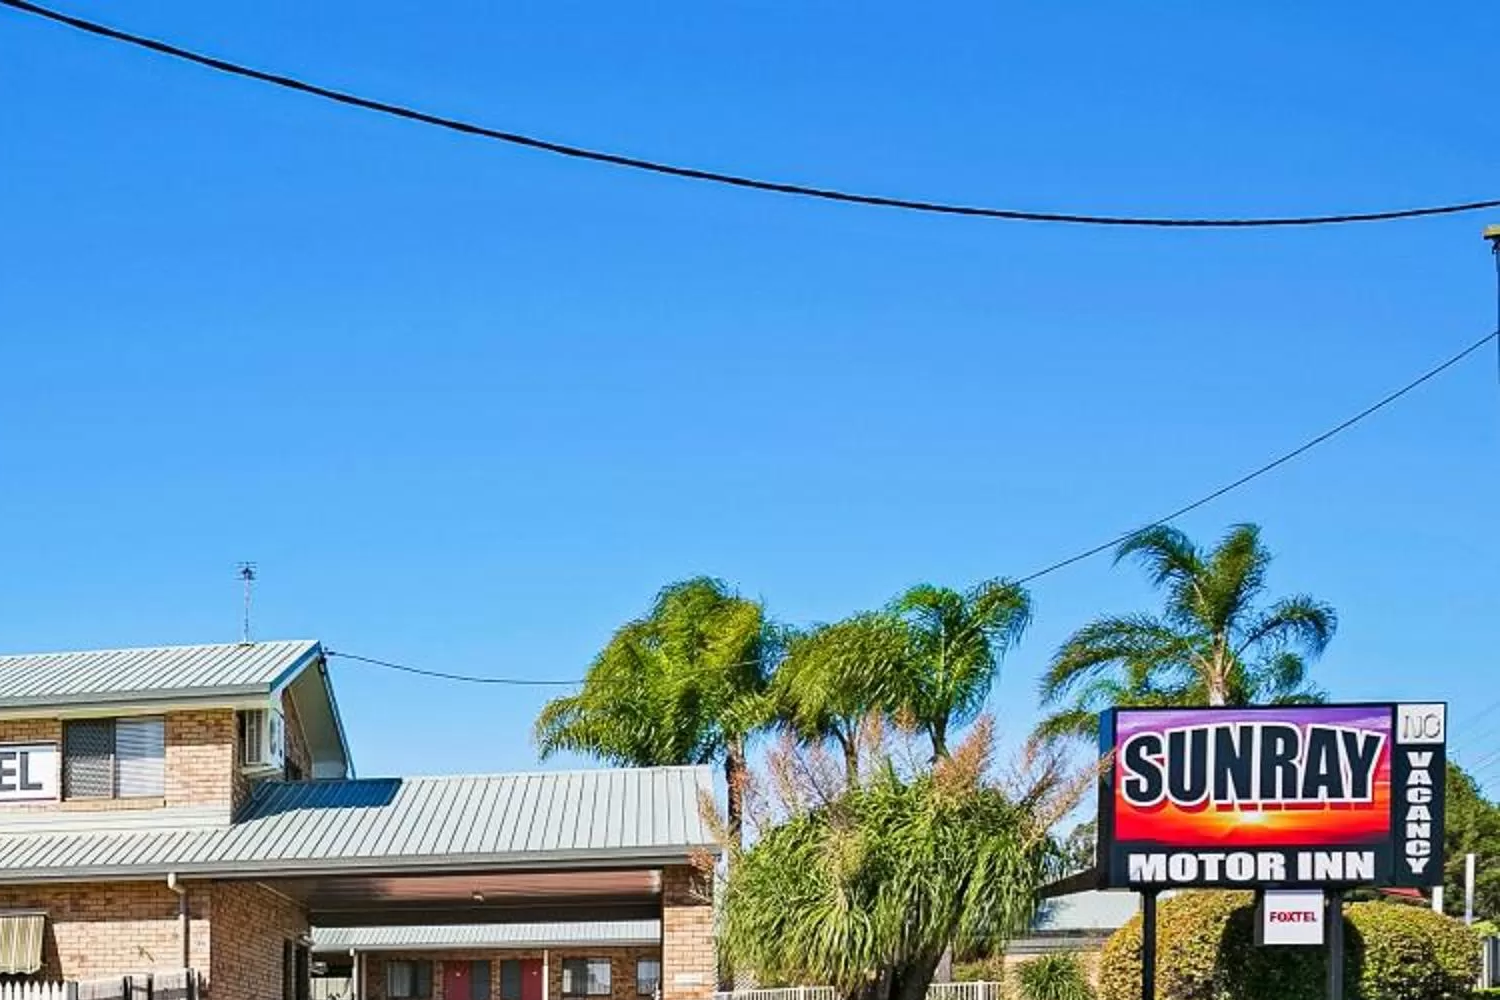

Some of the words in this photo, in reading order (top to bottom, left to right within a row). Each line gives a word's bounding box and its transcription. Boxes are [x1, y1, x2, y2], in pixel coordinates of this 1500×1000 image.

[1122, 722, 1385, 806] SUNRAY
[1405, 751, 1432, 874] VACANCY
[1129, 852, 1286, 882] MOTOR
[1297, 851, 1375, 880] INN
[1269, 911, 1317, 923] FOXTEL
